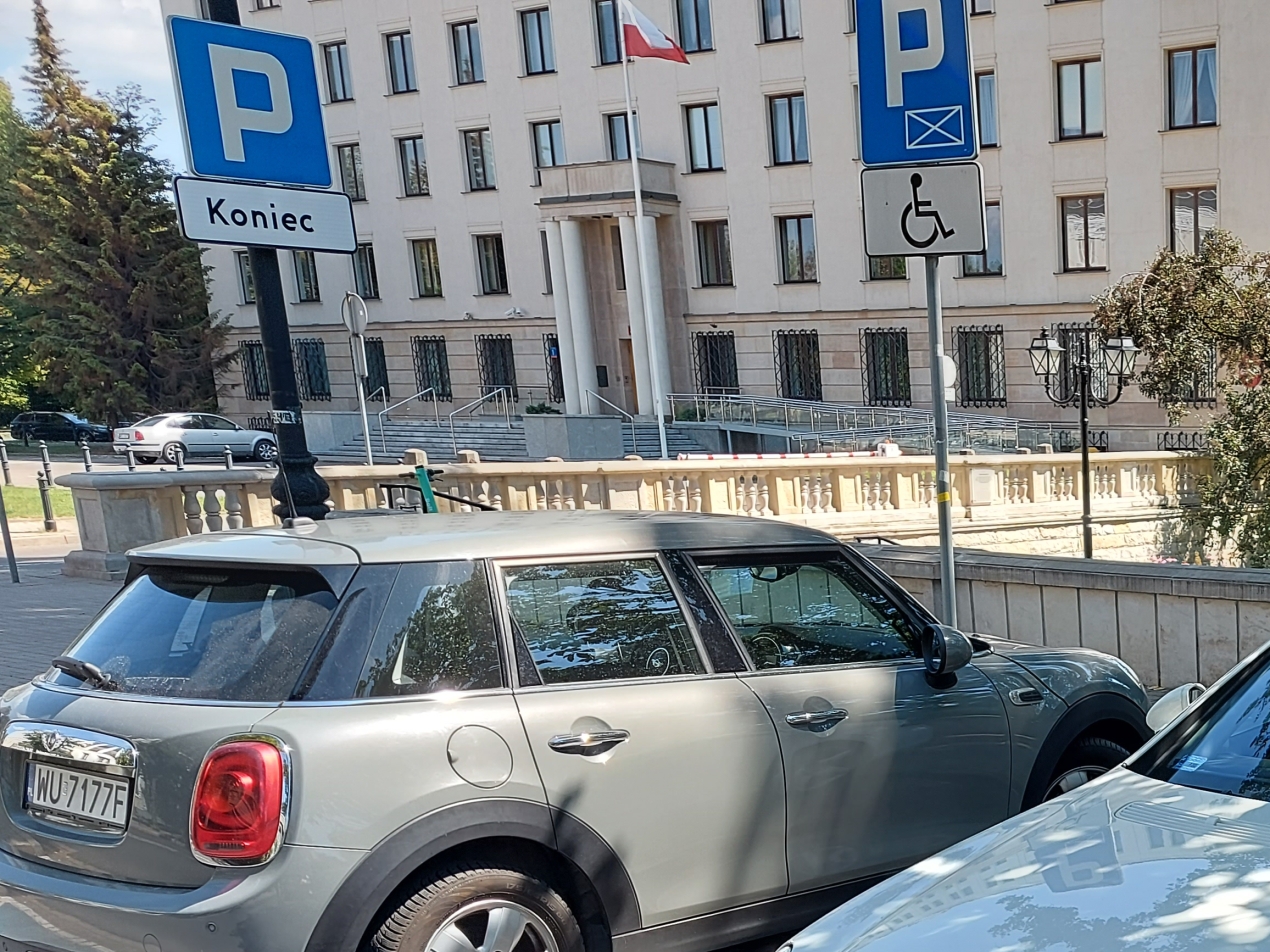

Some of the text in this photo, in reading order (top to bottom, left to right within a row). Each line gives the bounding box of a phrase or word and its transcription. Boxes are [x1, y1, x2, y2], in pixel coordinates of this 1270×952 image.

[882, 0, 945, 108] P
[207, 42, 294, 163] P
[205, 197, 315, 233] Koniec
[36, 768, 127, 819] WU 7177F
